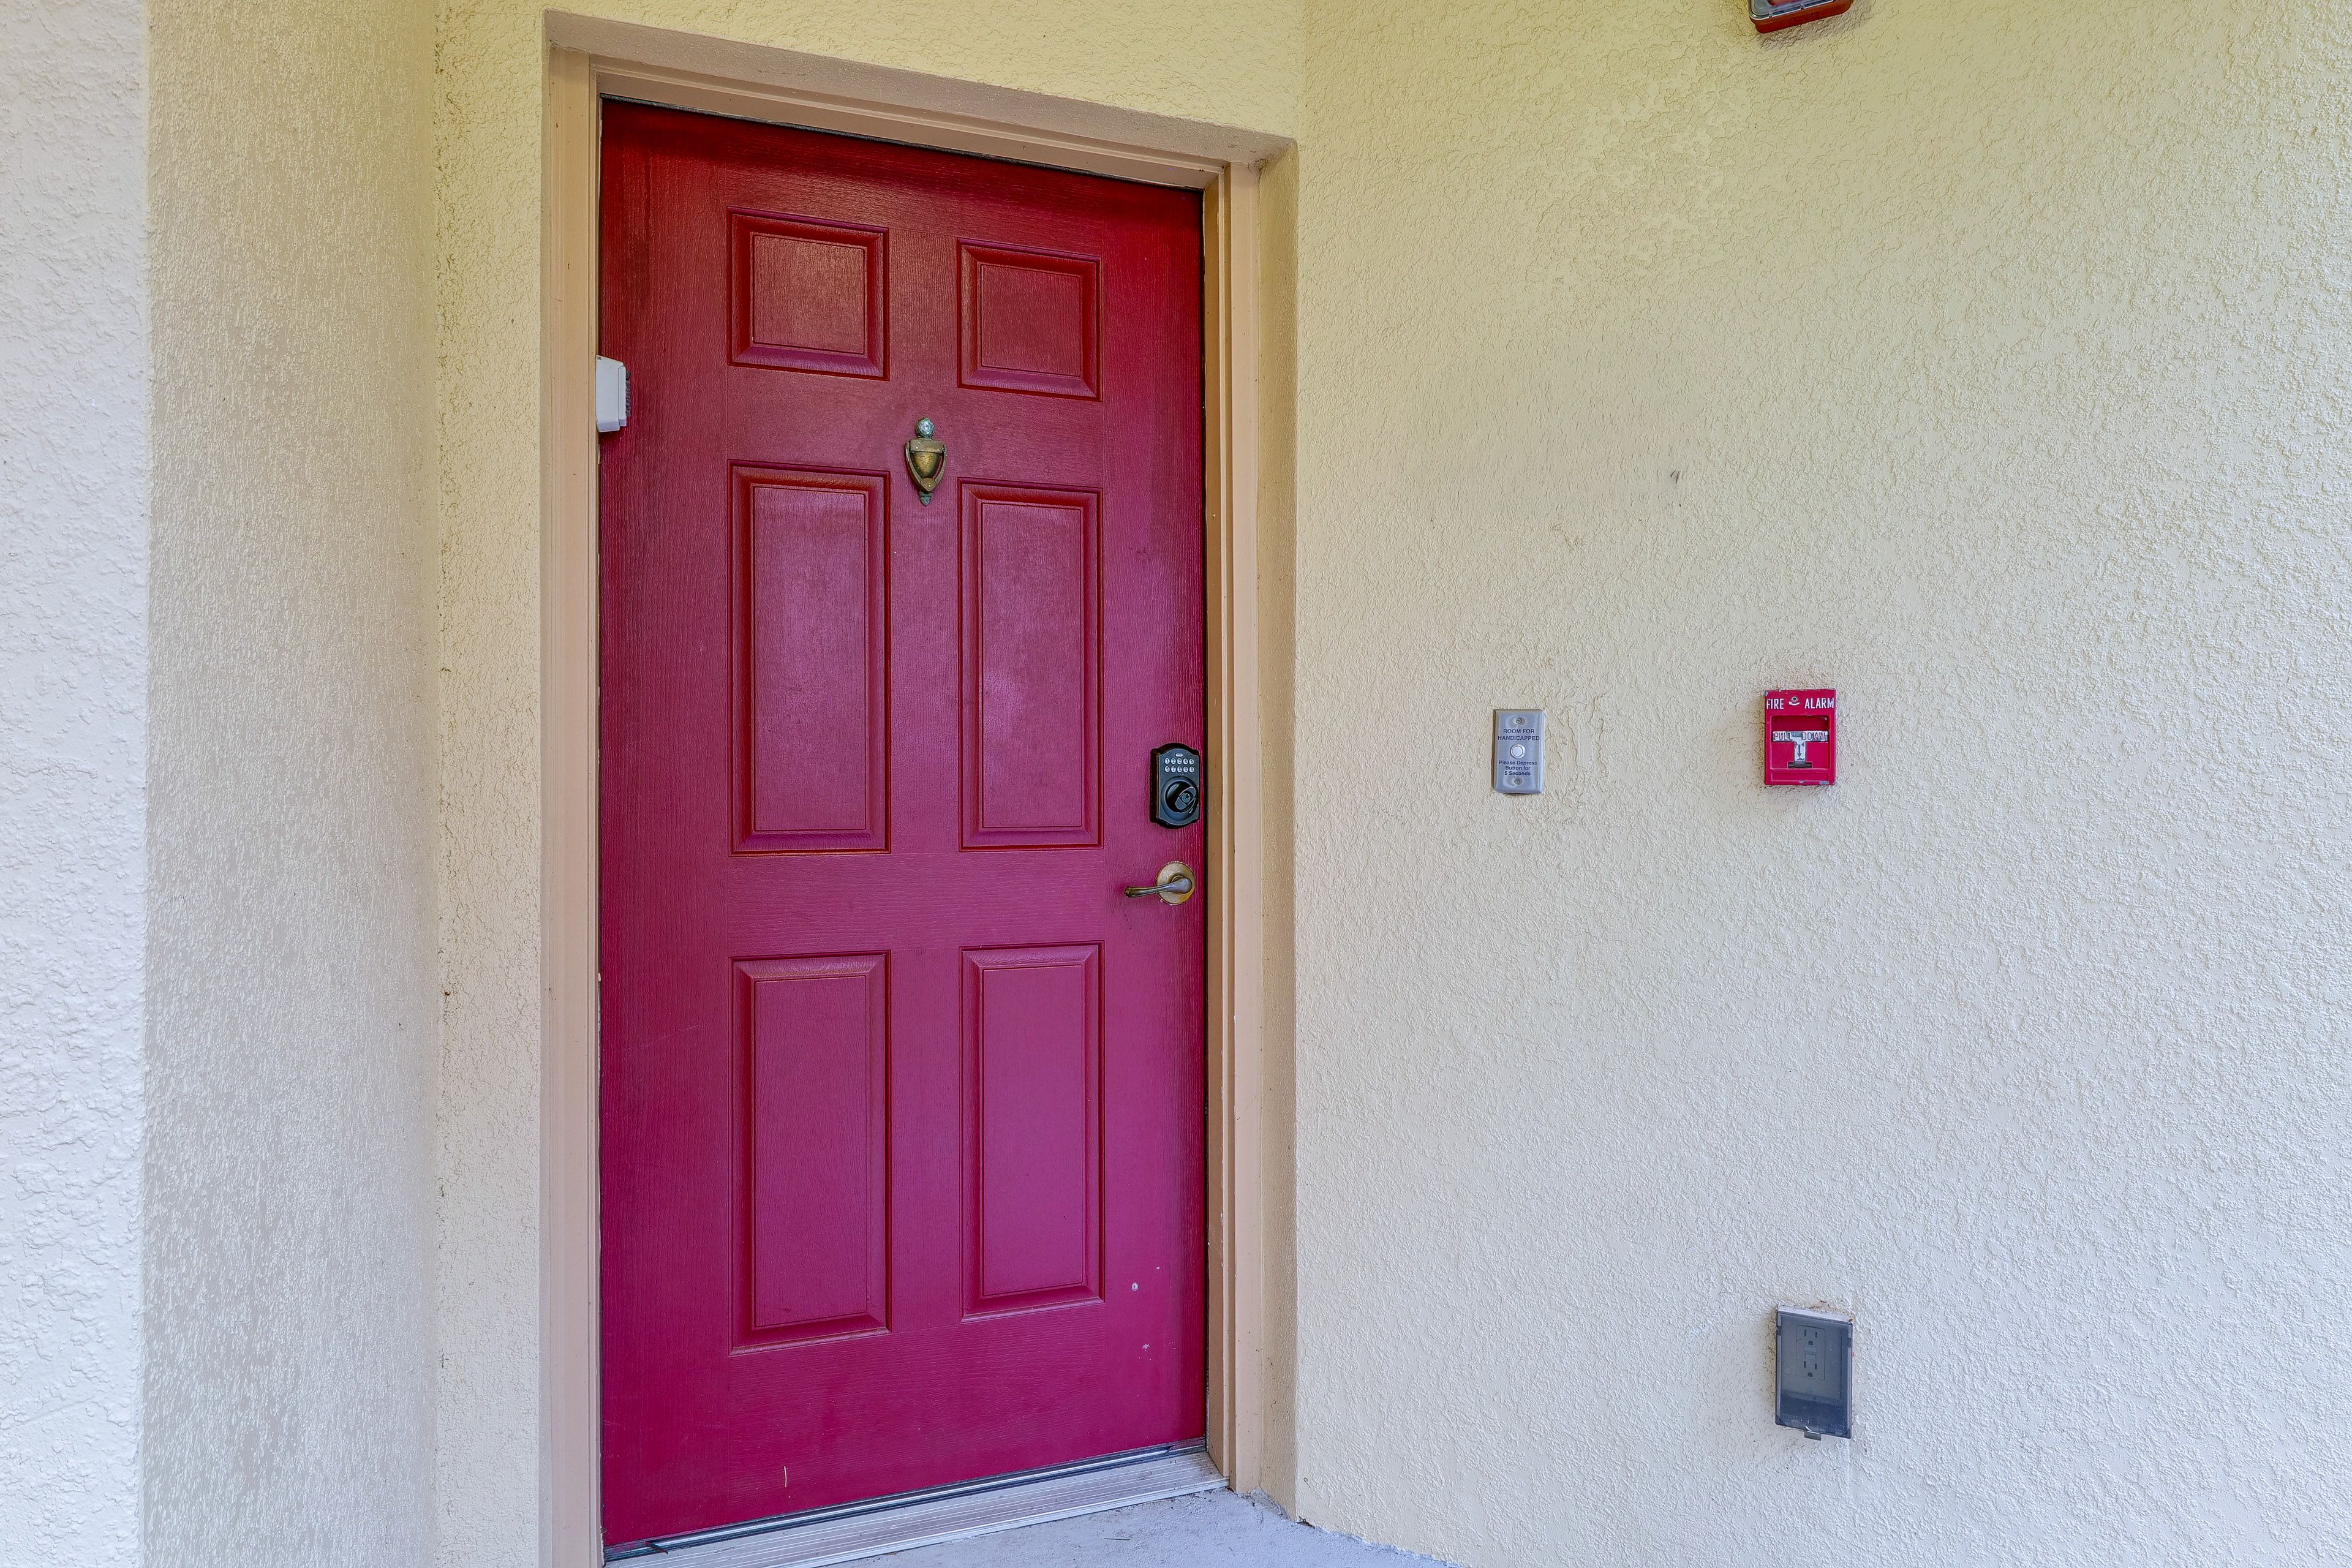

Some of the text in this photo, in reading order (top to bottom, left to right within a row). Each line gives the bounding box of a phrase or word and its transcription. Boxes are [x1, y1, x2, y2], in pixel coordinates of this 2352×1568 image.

[1766, 697, 1834, 709] FIRE ALARM
[1774, 732, 1826, 741] PULL DOWN
